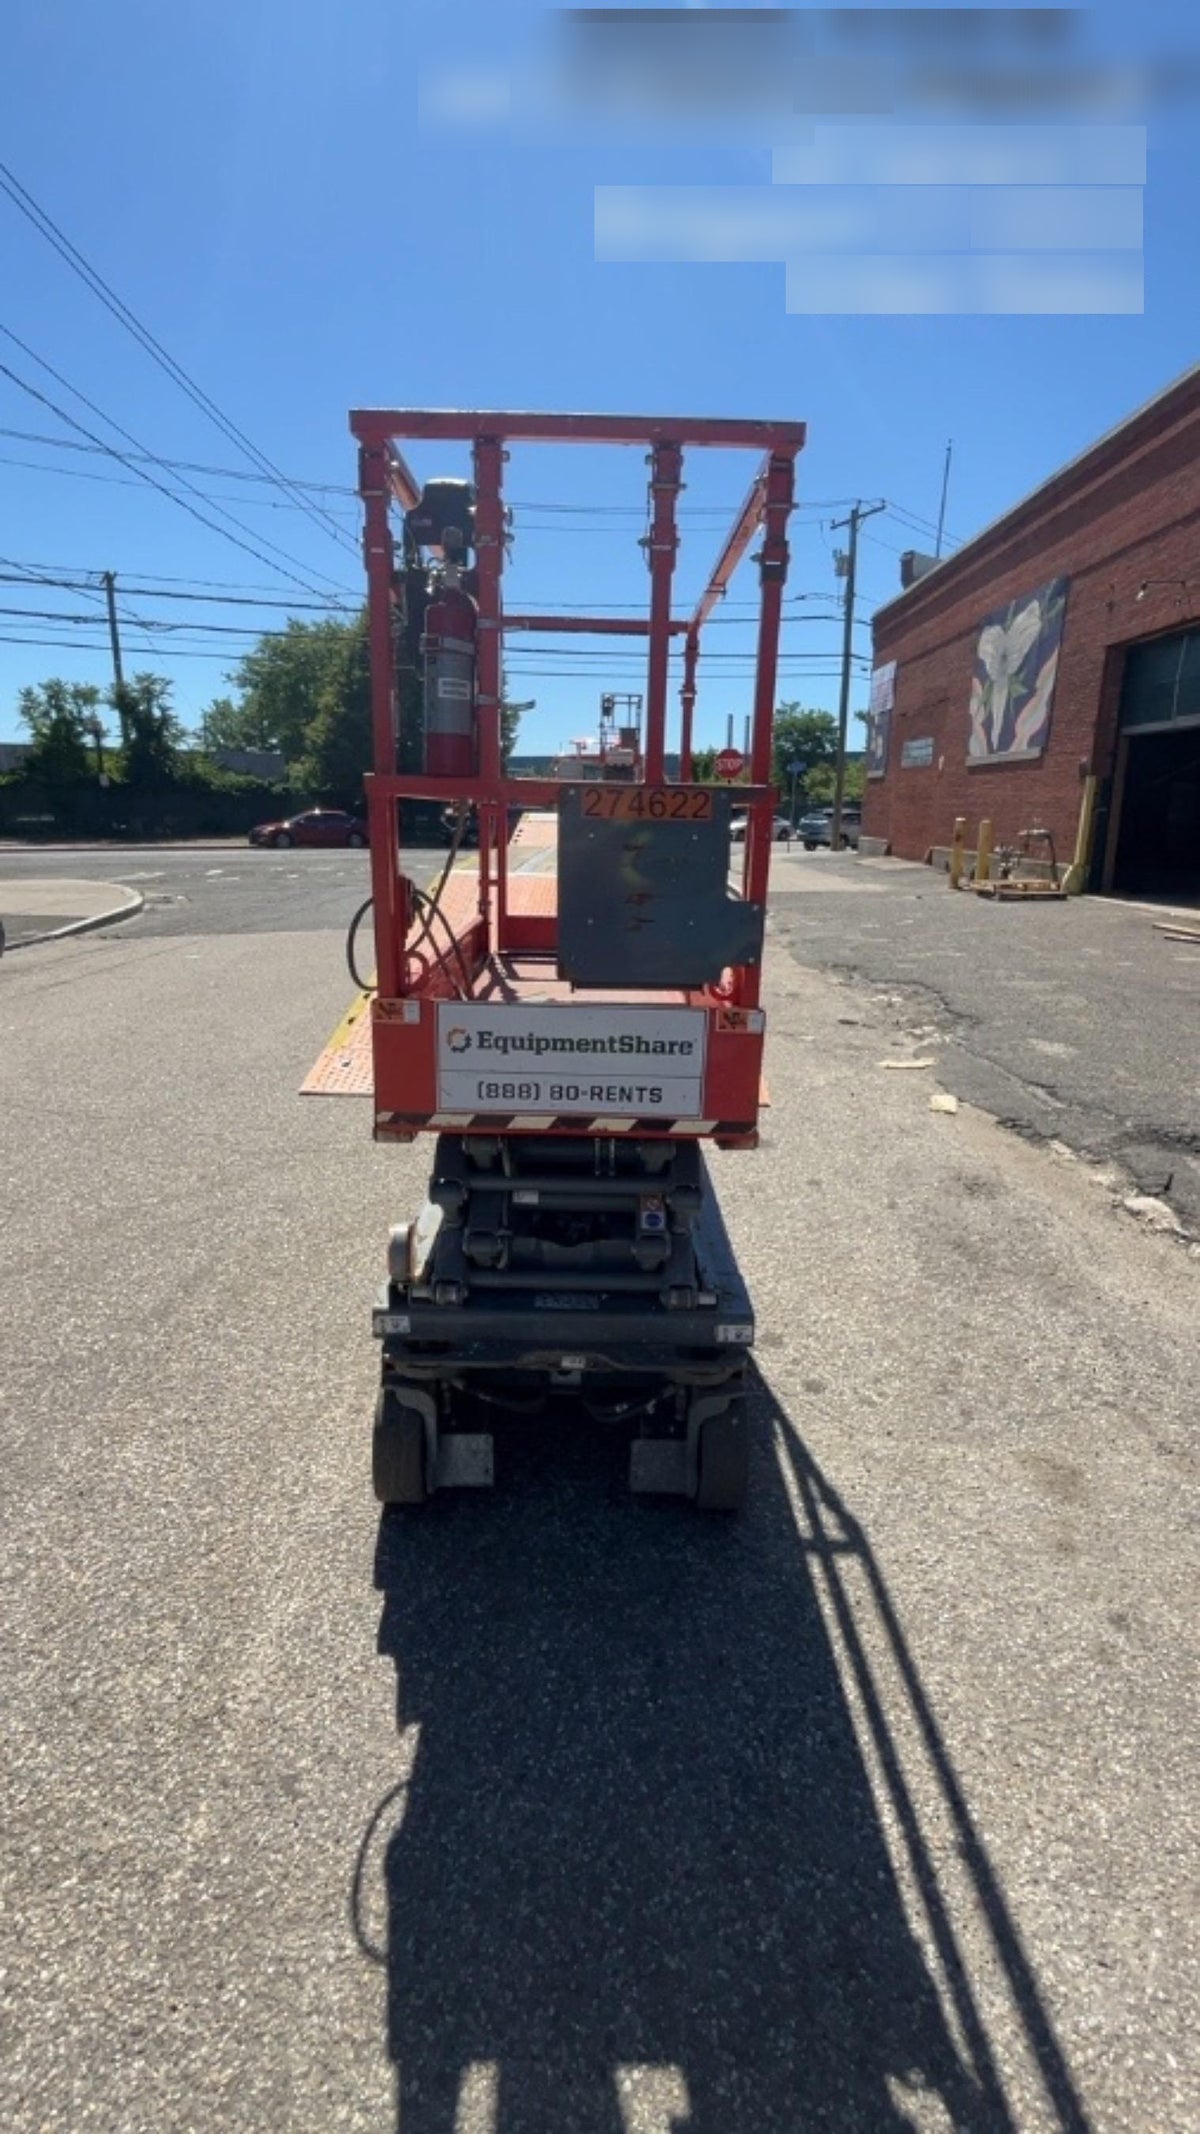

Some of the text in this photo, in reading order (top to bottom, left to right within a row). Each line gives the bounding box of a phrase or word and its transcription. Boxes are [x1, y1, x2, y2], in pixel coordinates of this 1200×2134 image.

[716, 758, 743, 770] STOP
[585, 789, 711, 818] 274622
[477, 1031, 693, 1056] EquipmentShare
[478, 1081, 540, 1100] (888)
